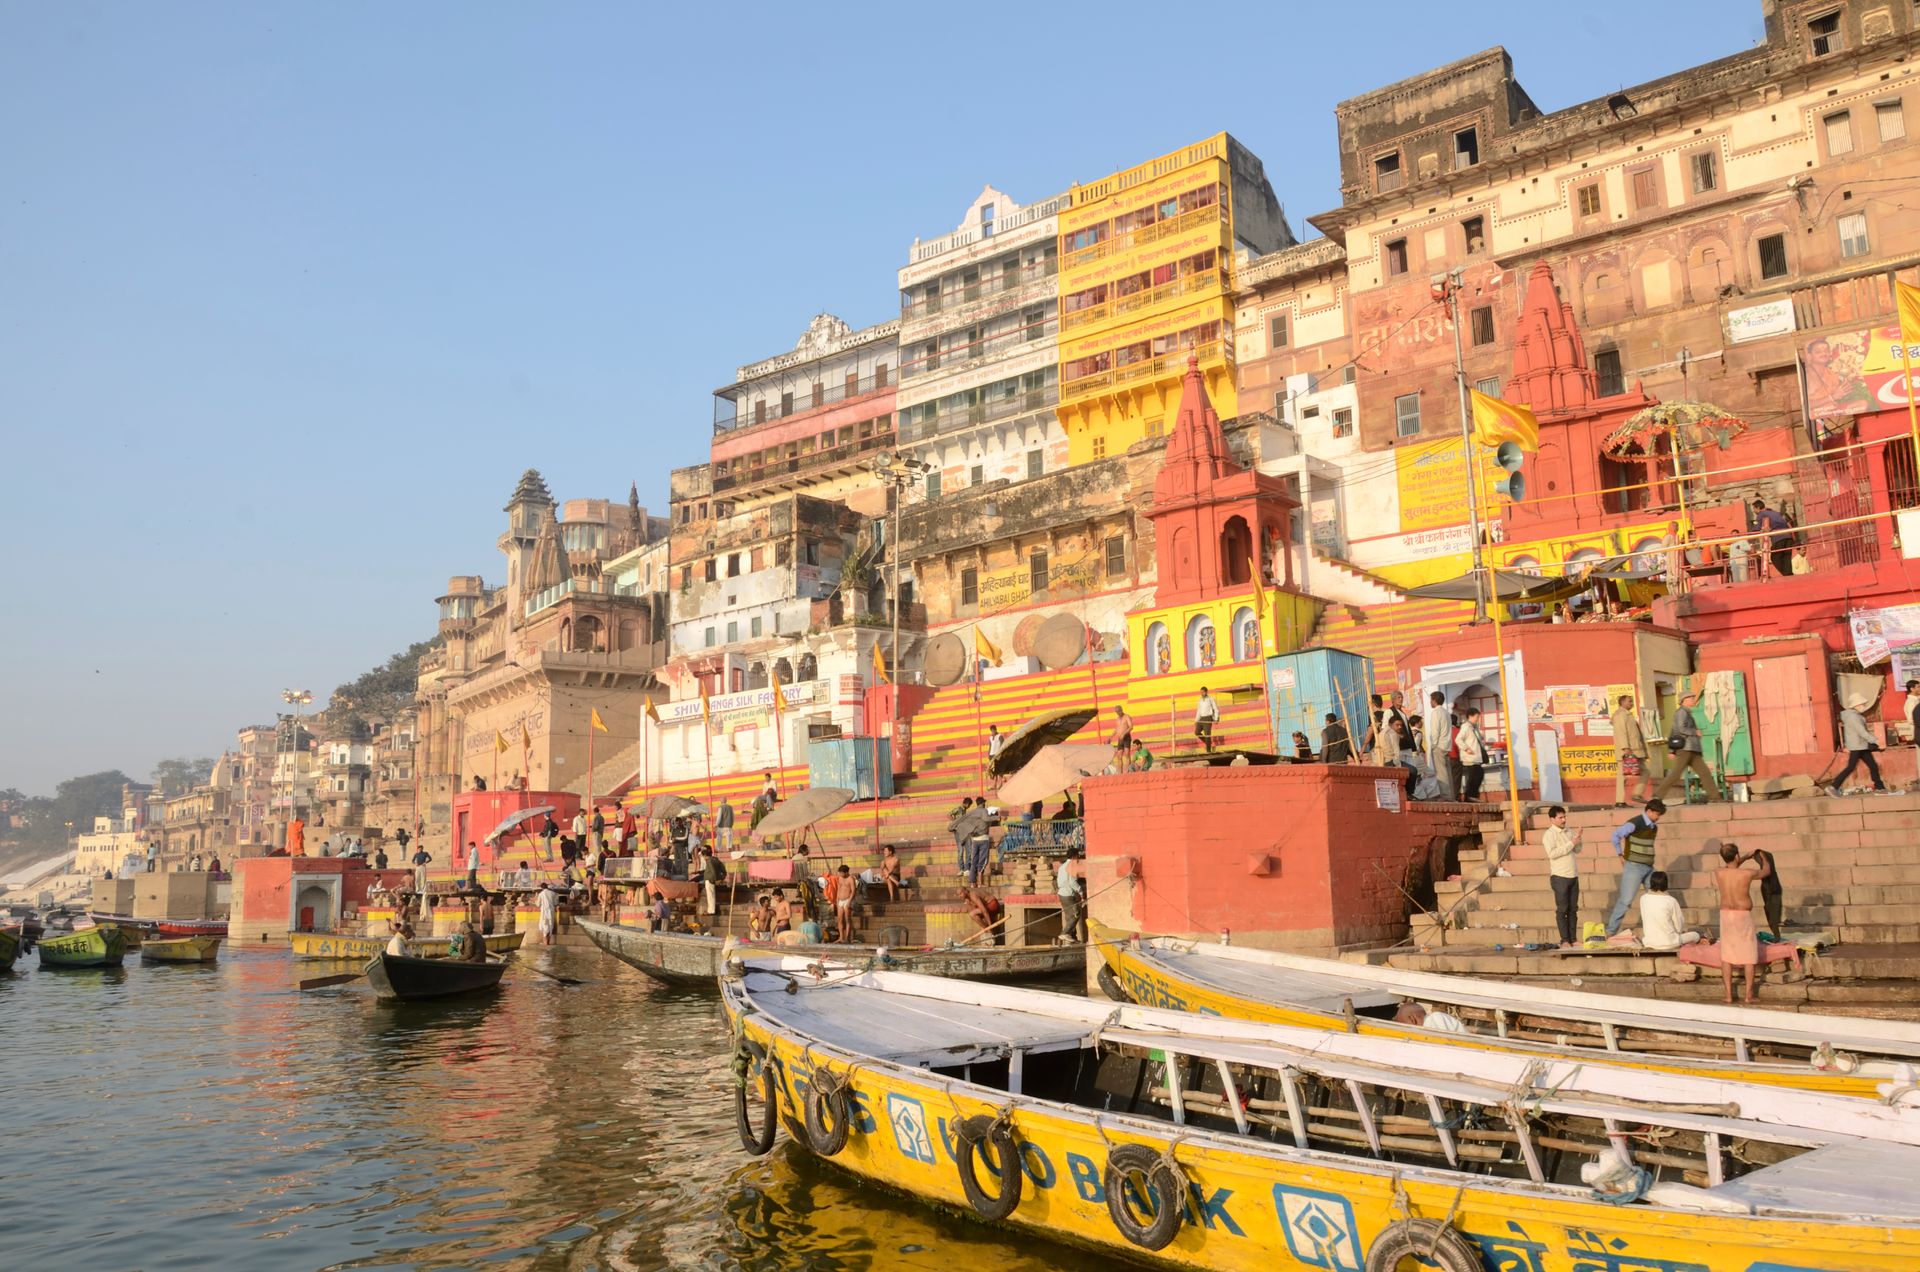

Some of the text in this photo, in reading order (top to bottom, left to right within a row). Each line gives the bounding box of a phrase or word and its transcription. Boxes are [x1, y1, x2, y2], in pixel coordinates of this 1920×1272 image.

[1018, 573, 1029, 585] घाट
[979, 589, 1029, 609] AHILYABAI GHAT
[674, 702, 700, 716] SHIV
[710, 698, 733, 711] ANGA
[736, 695, 753, 707] SILK
[757, 687, 802, 705] FACORY
